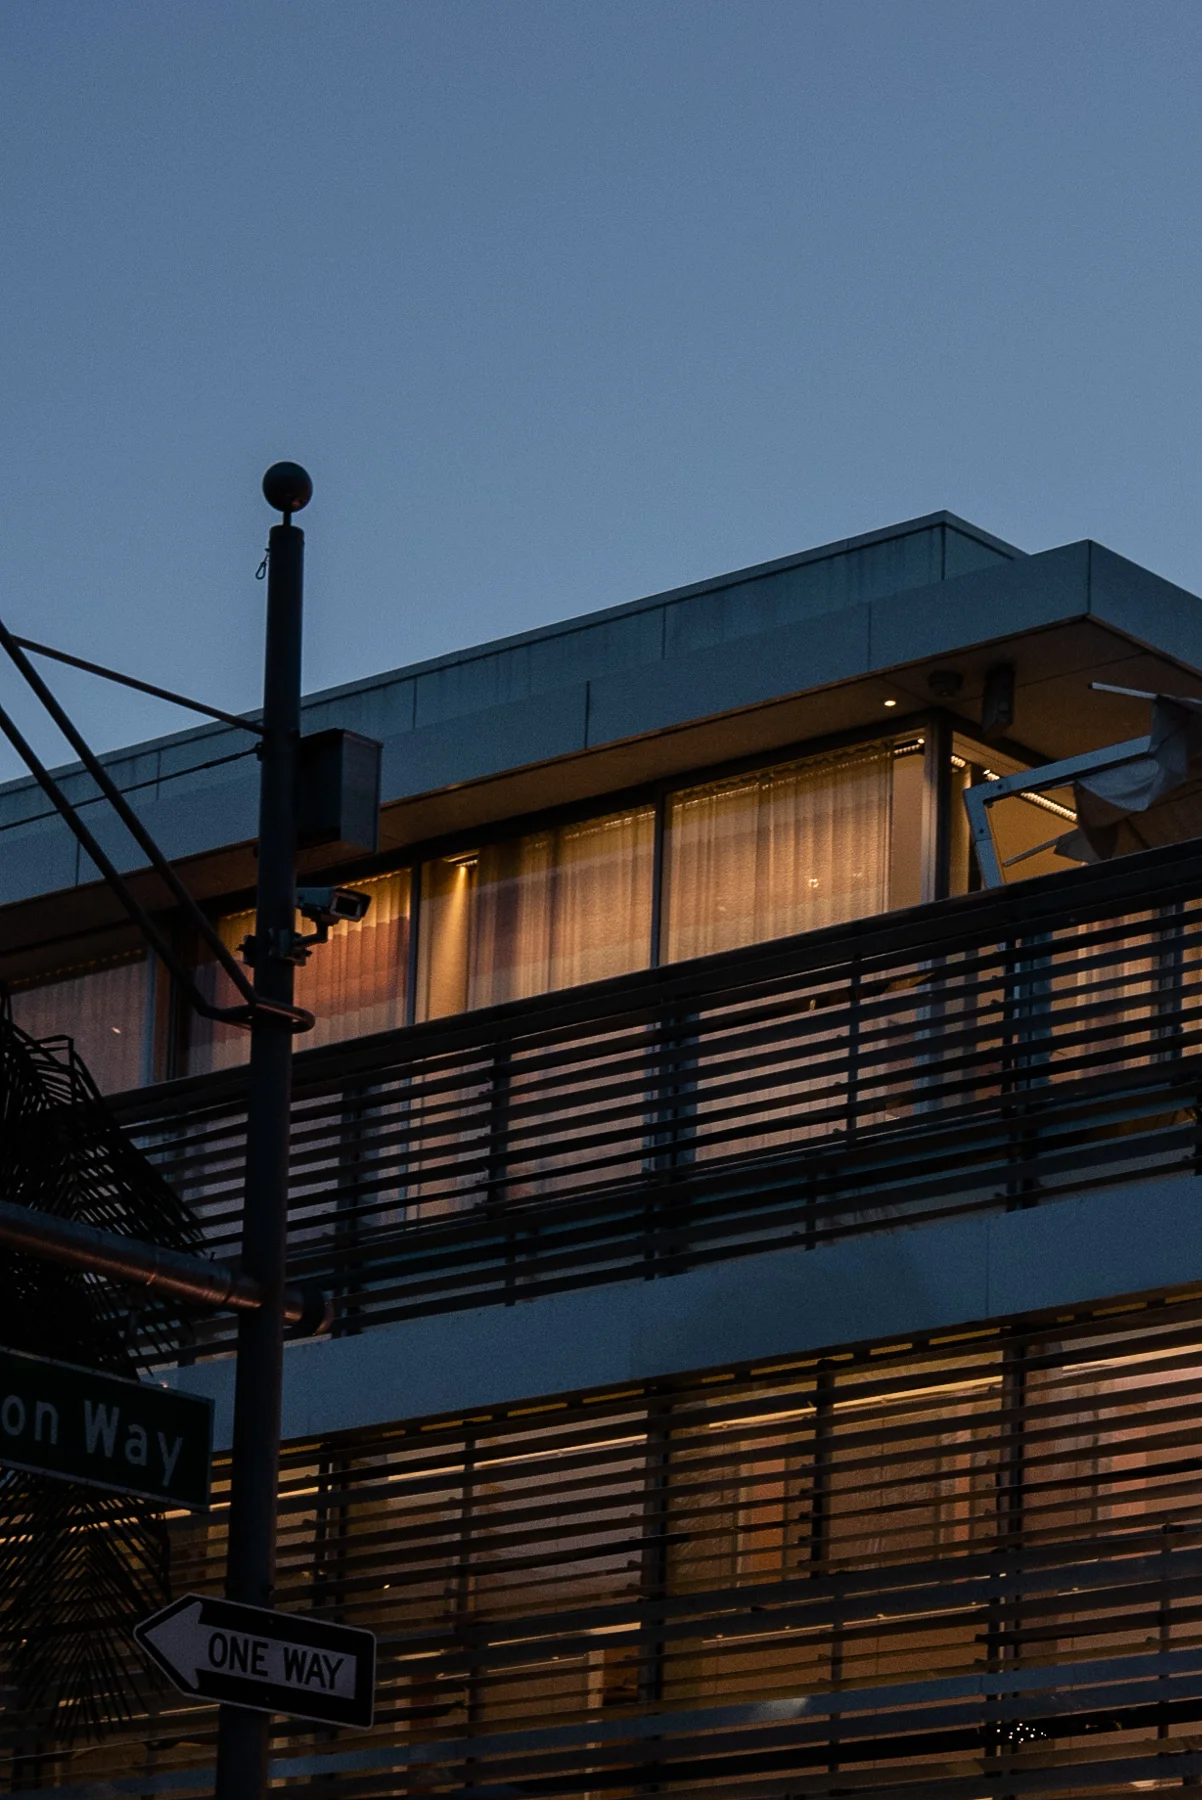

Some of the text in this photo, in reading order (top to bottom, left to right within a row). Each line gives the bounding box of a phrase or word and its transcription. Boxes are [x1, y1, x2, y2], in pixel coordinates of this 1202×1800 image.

[83, 1398, 184, 1488] Way
[208, 1632, 344, 1690] ONE WAY
